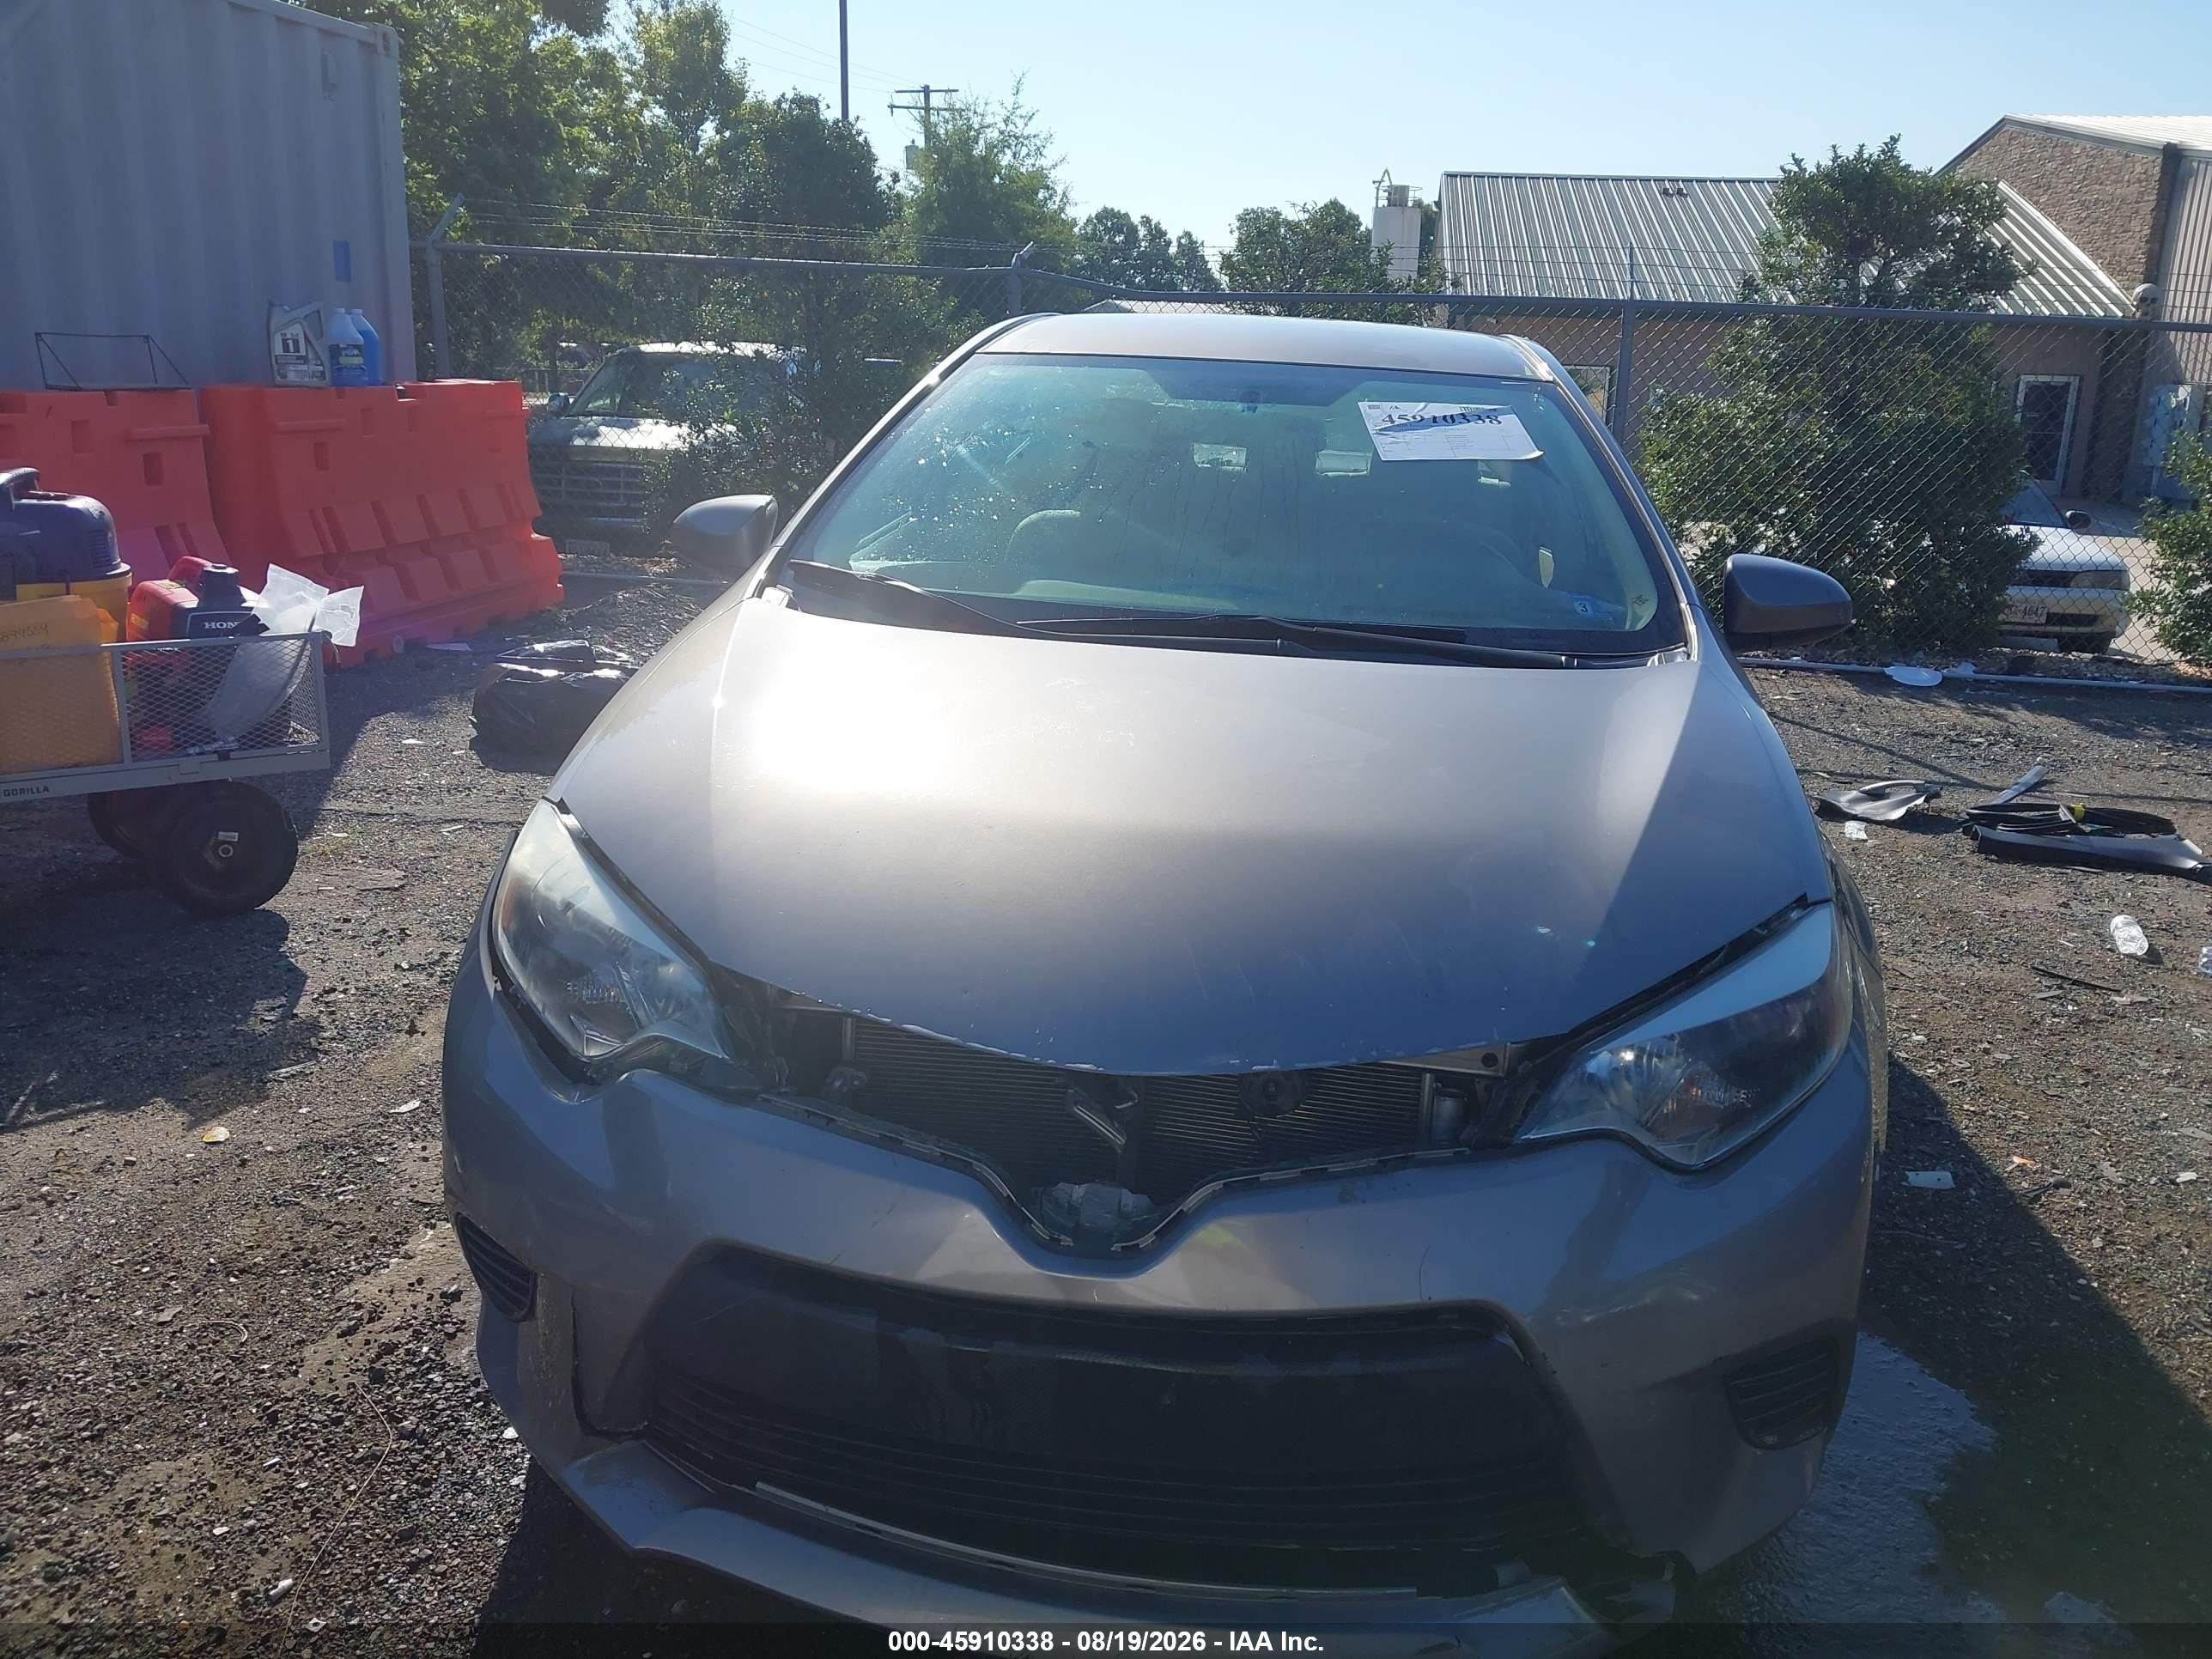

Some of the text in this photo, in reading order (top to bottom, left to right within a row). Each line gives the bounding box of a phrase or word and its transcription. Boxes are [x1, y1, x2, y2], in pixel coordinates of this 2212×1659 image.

[1381, 412, 1503, 425] 45910338
[1578, 602, 1589, 613] 3
[204, 621, 240, 629] HON
[3, 785, 50, 798] GORILLA
